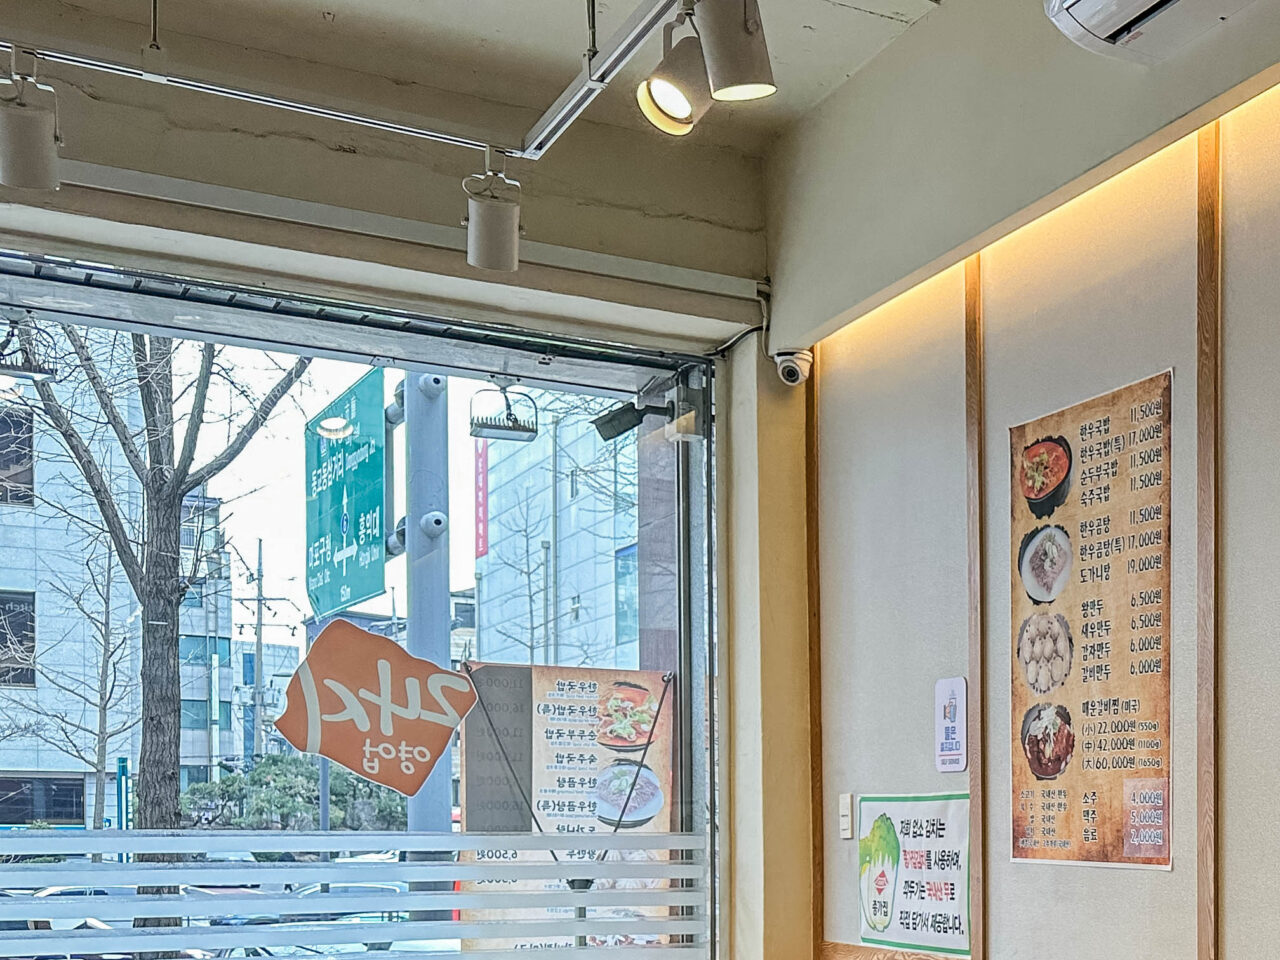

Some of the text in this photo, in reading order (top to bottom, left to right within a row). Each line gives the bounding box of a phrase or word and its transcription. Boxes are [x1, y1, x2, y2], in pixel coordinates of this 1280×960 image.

[1080, 399, 1162, 442] 한우국밥 11,500원
[1080, 422, 1162, 464] 한우국밥(특) 17,000원
[1081, 446, 1162, 486] 순두부국밥 11,500원
[1081, 470, 1162, 507] 숙주국밥 11,500원
[358, 505, 380, 545] 홍익대
[1080, 505, 1162, 539] 한우곰탕 11,500원
[1080, 529, 1162, 561] 한우곰탕(특) 17,000원
[1080, 554, 1162, 583] 도가니탕 19,000원
[1081, 589, 1162, 618] 왕만두 6,500원
[1081, 612, 1162, 639] 새우만두 6,500원
[1081, 635, 1162, 661] 감자만두 6,000원
[1081, 658, 1162, 683] 갈비만두 6,000원
[1082, 698, 1140, 716] 매운갈비찜 (미국)
[1097, 719, 1136, 735] 22,000원
[1097, 737, 1135, 752] 42,000원
[1082, 791, 1162, 805] 소주 4,000원
[912, 820, 923, 838] 업소
[925, 818, 946, 838] 김치는
[1082, 809, 1162, 825] 맥주 5,000원
[1082, 828, 1162, 844] 음료 2,000원
[933, 850, 961, 870] 사용하며,
[903, 880, 925, 900] 깍두기는
[899, 911, 911, 930] 직접
[930, 913, 964, 934] 제공합니다.
